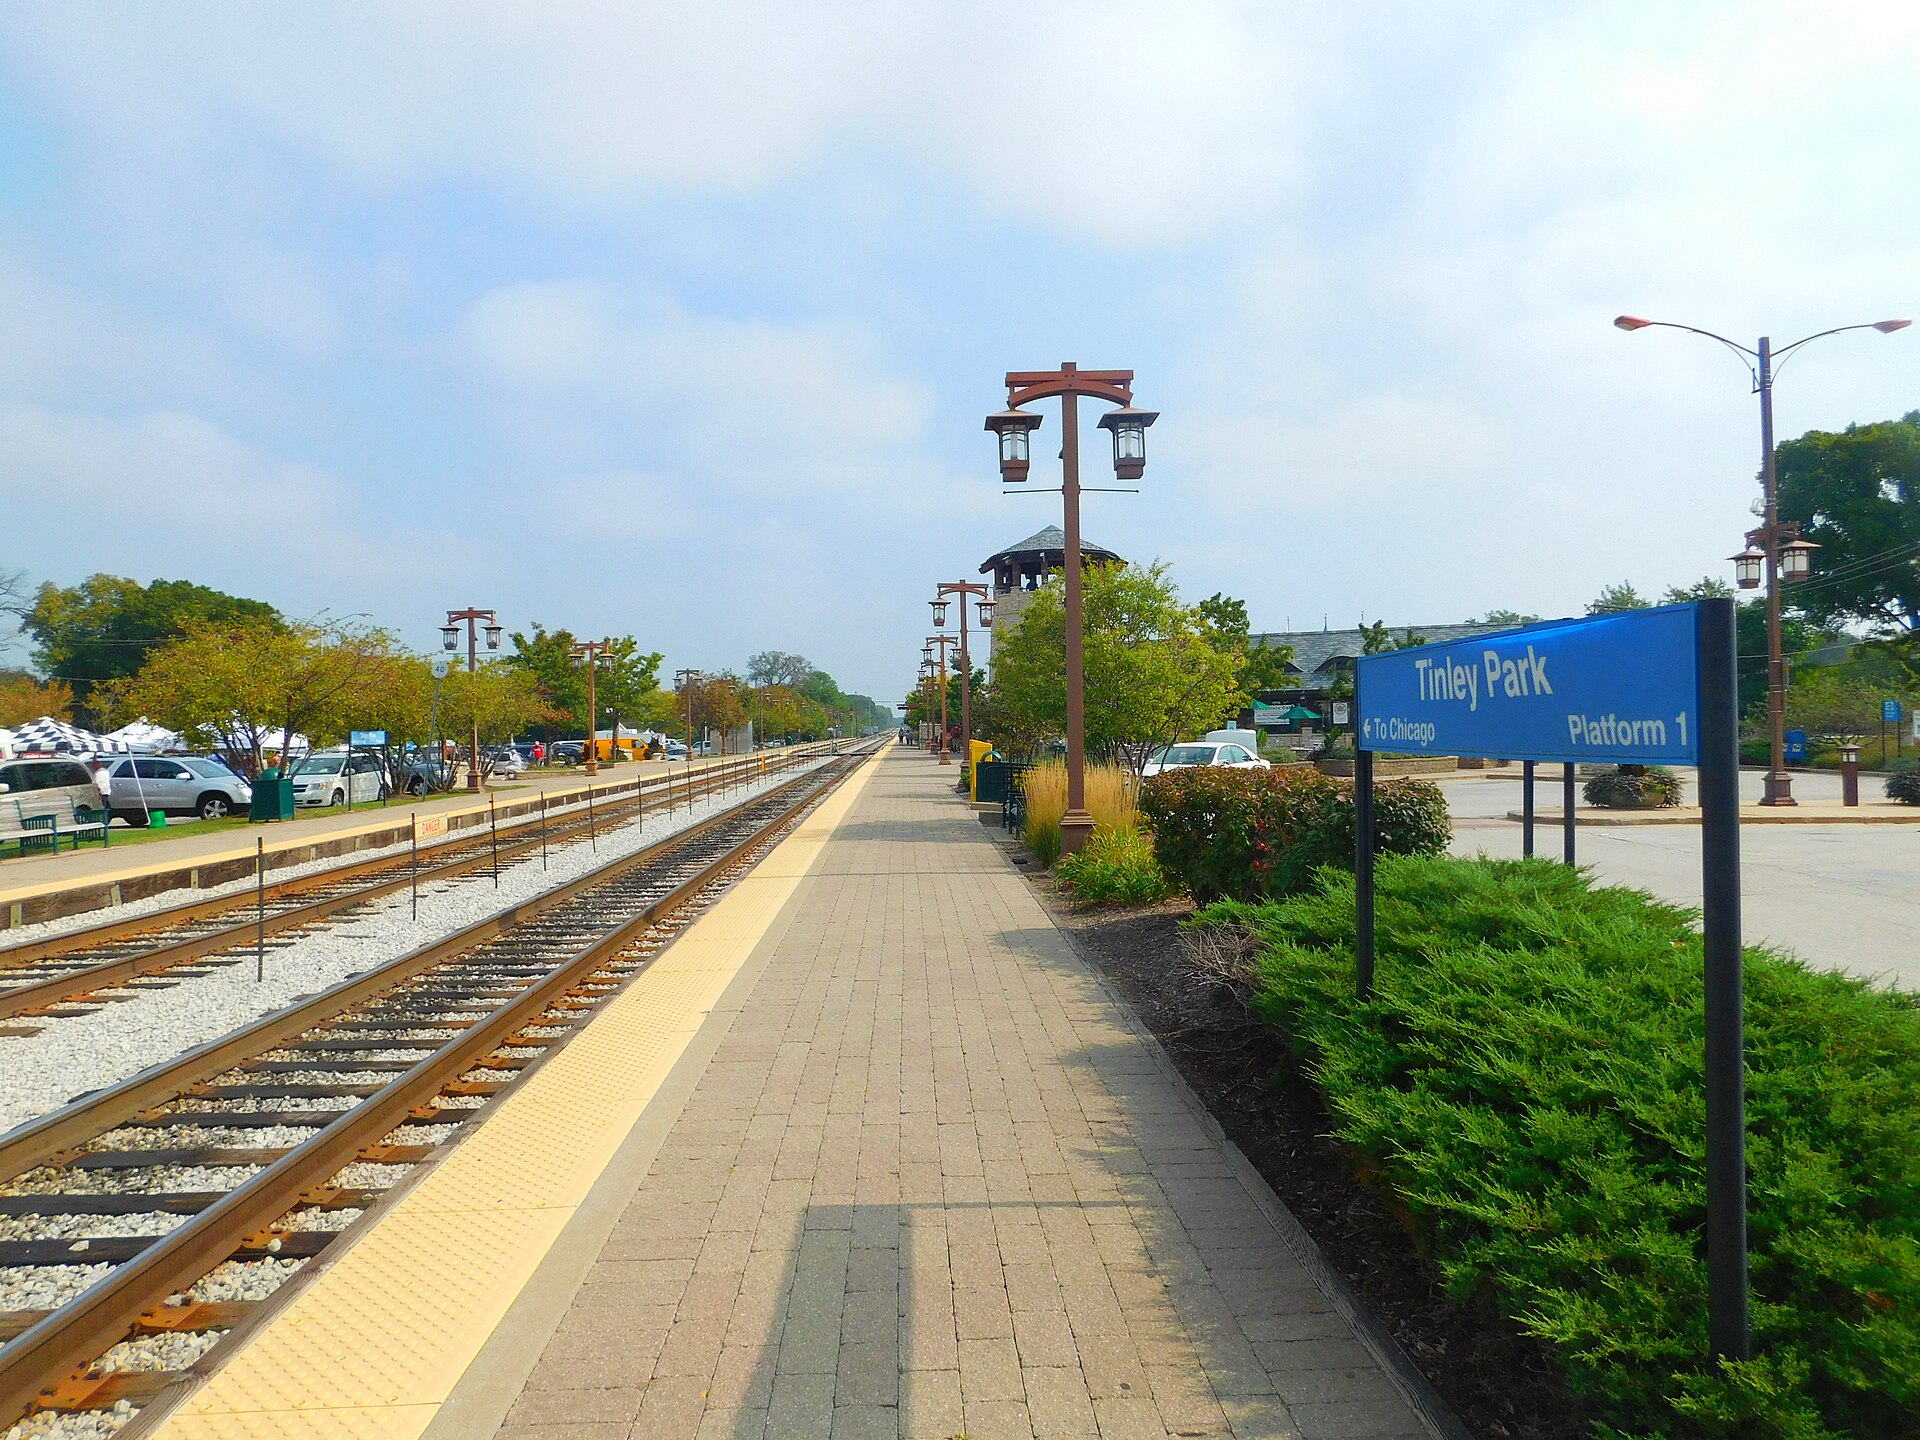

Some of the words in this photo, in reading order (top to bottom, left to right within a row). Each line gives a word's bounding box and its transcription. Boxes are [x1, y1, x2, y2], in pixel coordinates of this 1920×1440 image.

[435, 665, 444, 673] 40
[1415, 656, 1477, 711] Tinley
[1484, 645, 1553, 697] Park
[1374, 718, 1386, 740] To
[1390, 718, 1435, 746] Chicago
[1568, 713, 1666, 745] Platform
[1675, 711, 1687, 745] 1
